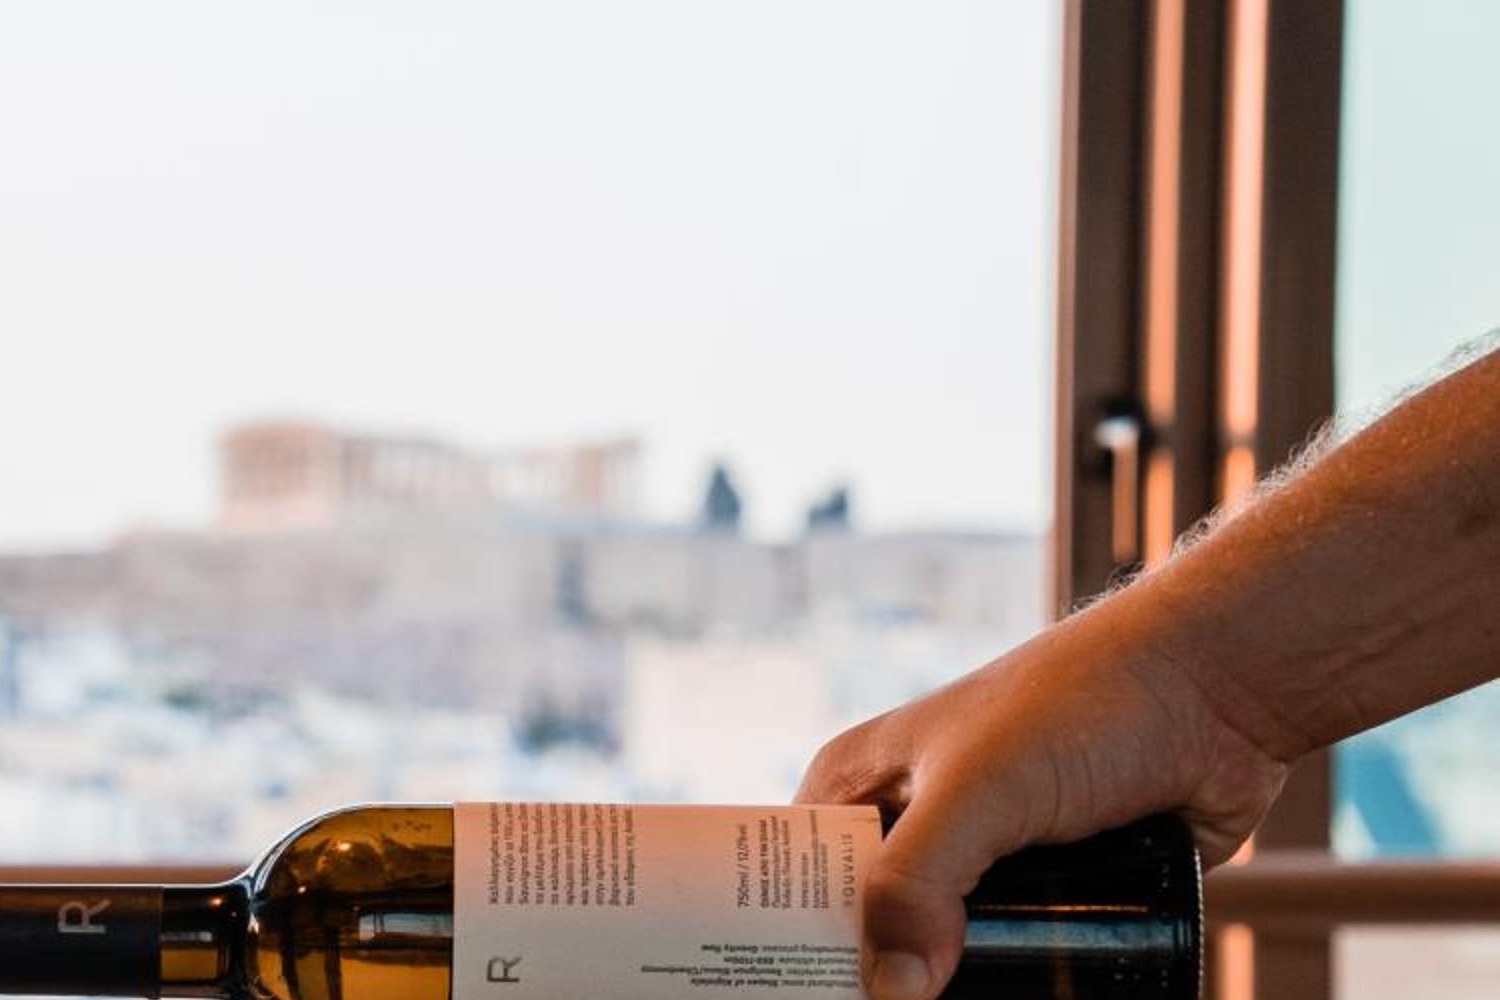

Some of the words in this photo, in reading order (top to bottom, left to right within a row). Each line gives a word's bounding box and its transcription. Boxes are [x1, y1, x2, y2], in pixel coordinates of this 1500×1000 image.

[737, 872, 749, 908] 750ml
[58, 900, 110, 934] R
[486, 956, 522, 983] R
